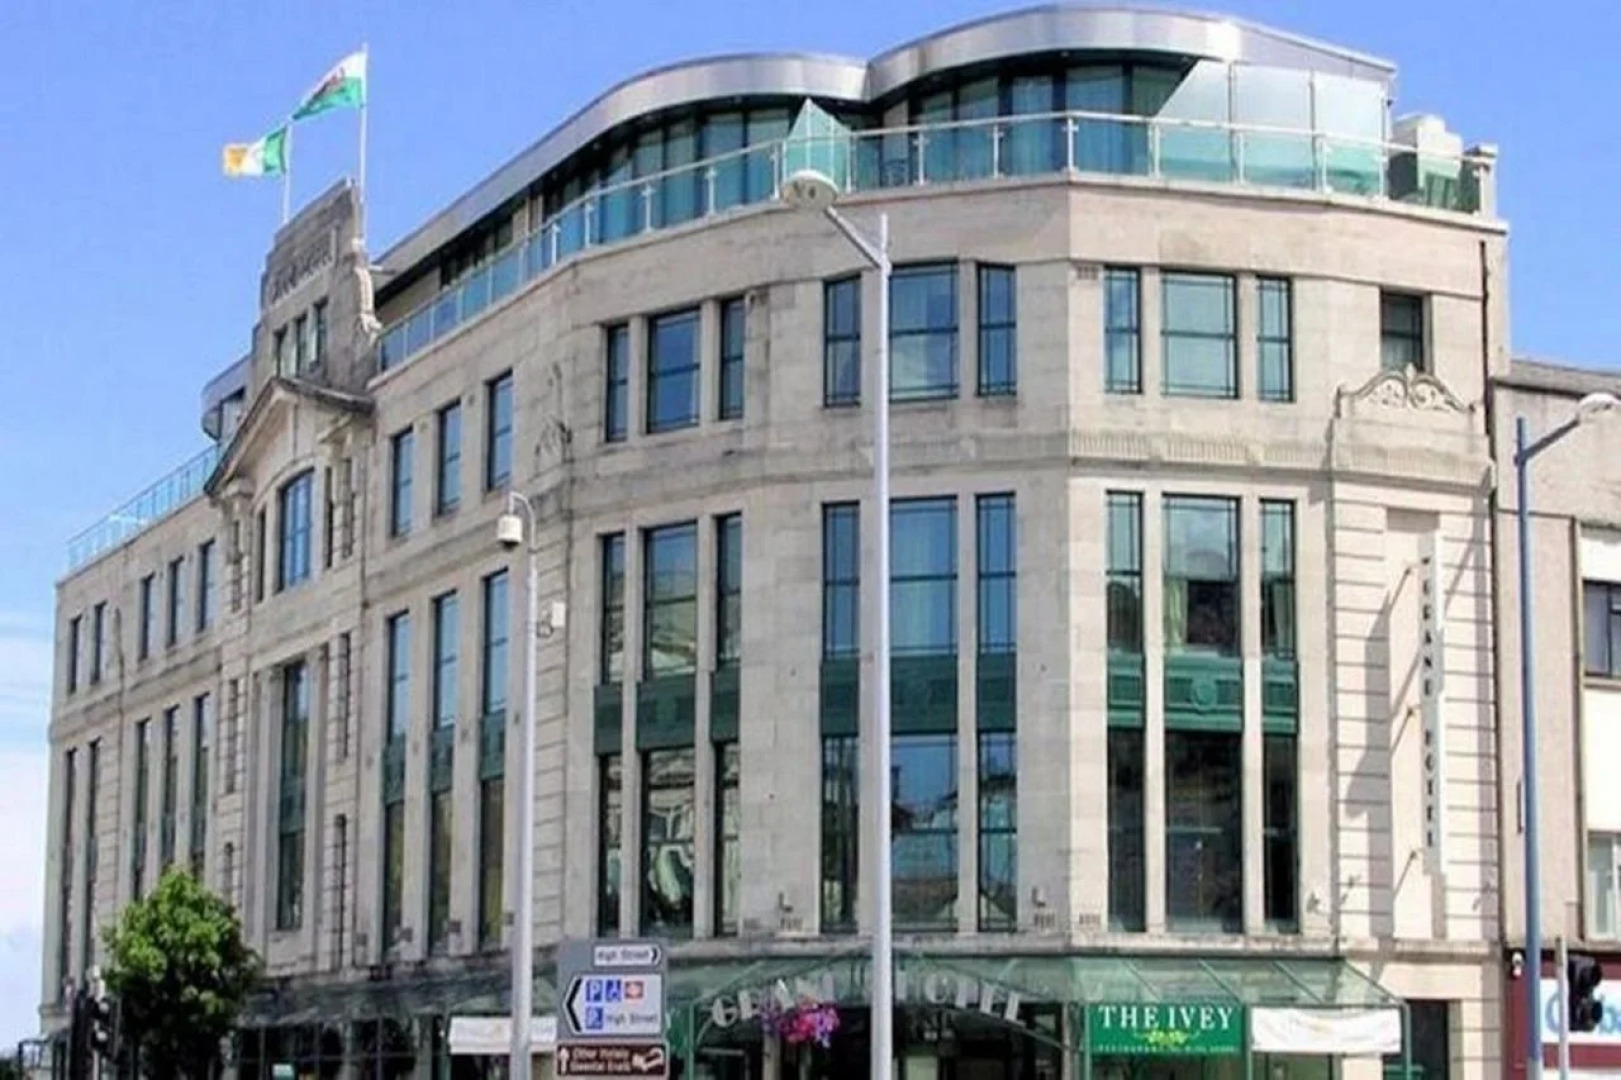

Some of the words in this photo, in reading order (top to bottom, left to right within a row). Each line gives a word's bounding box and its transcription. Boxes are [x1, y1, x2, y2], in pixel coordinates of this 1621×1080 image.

[597, 949, 617, 961] High
[620, 949, 650, 959] Street
[1098, 1005, 1160, 1029] THE
[1169, 1005, 1233, 1030] IVEY
